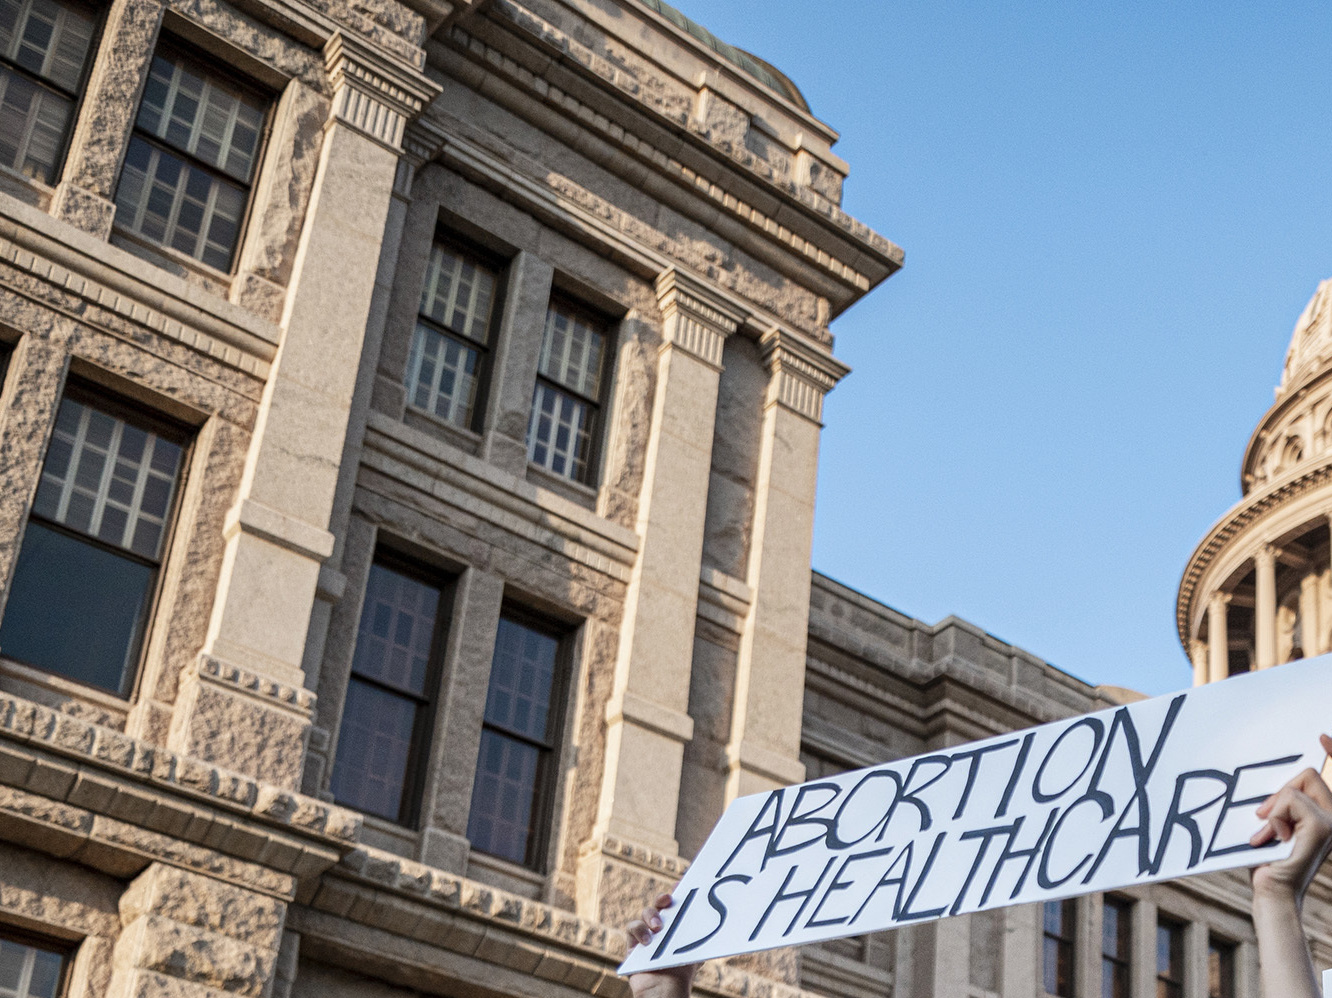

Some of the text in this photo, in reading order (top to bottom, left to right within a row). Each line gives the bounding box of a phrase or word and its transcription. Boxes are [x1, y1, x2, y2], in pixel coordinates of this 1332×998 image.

[650, 754, 1304, 961] IS HEALTHCARE
[716, 694, 1187, 878] ABORTION
